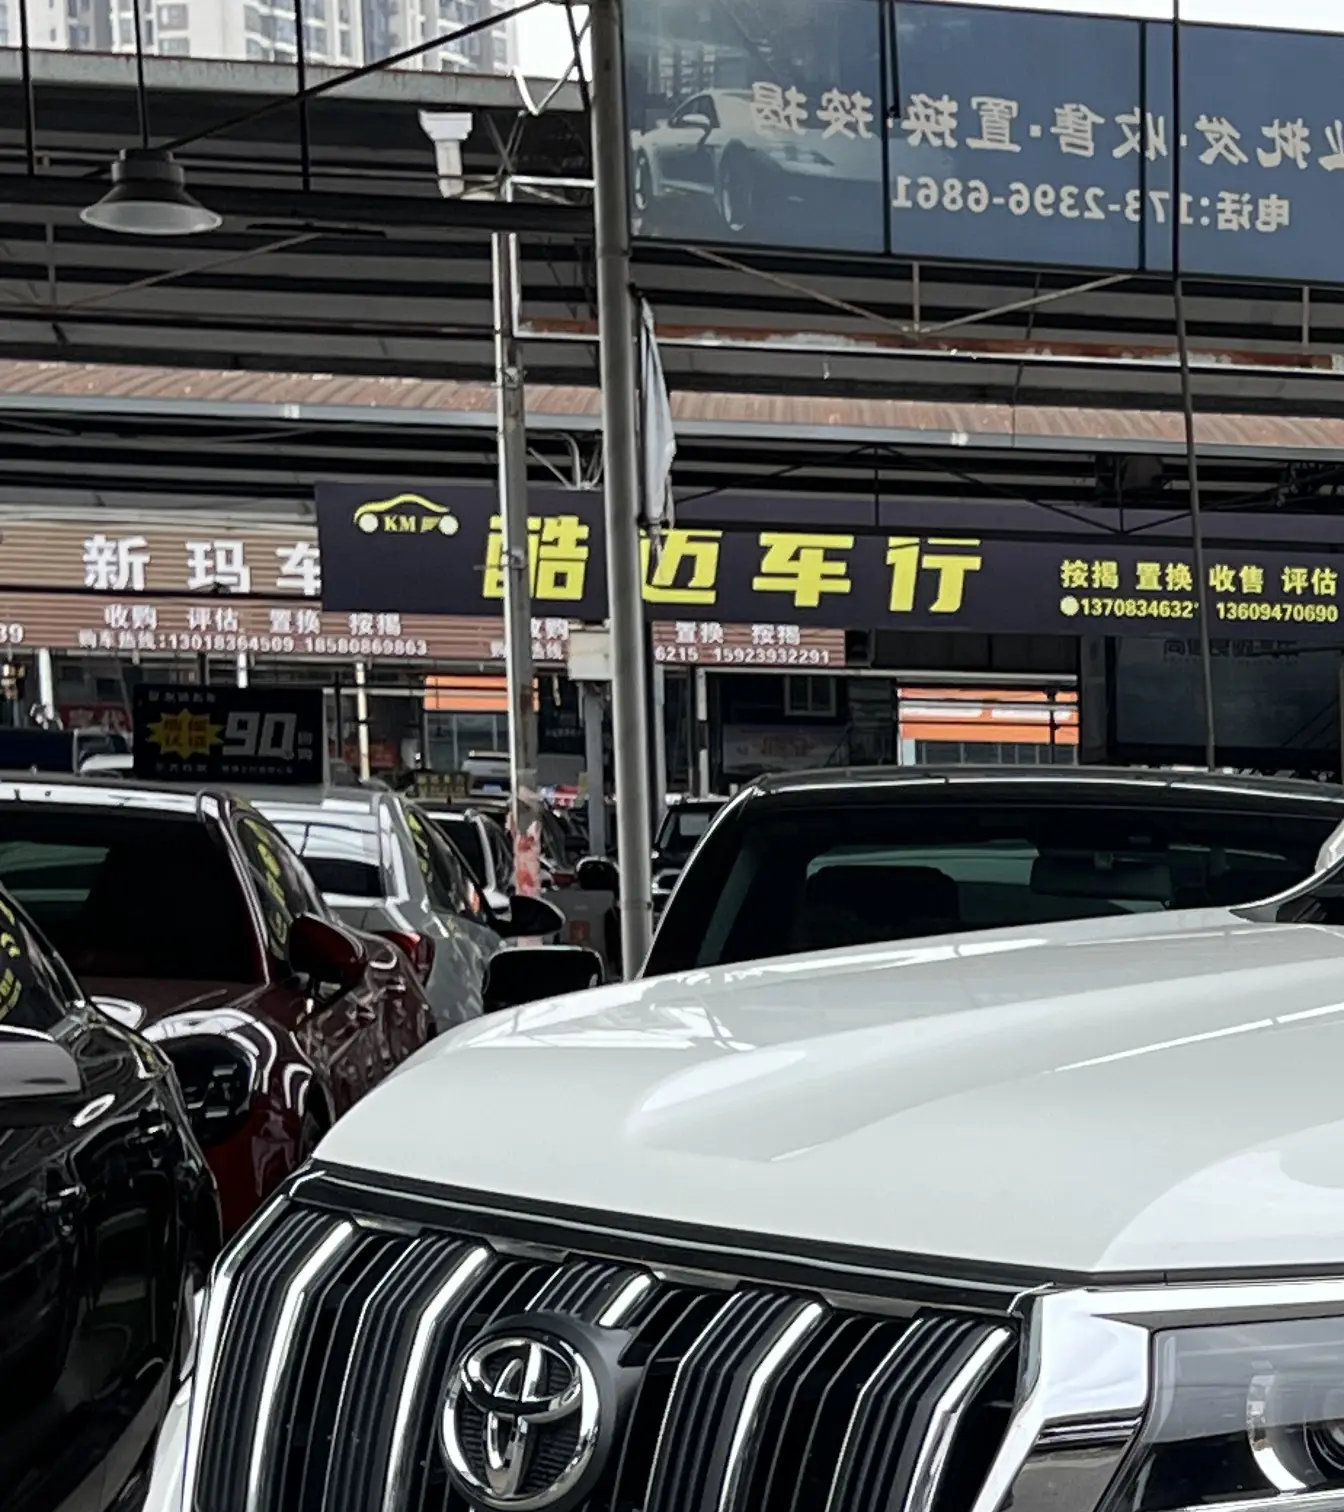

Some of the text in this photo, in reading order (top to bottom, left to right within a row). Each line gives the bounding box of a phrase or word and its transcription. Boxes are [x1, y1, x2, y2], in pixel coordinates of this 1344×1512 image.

[384, 515, 417, 533] KM
[483, 514, 982, 614] 酷迈车行
[1060, 560, 1338, 596] 按揭 置换 收售 评估
[1081, 598, 1338, 622] 1370834632 13609470690
